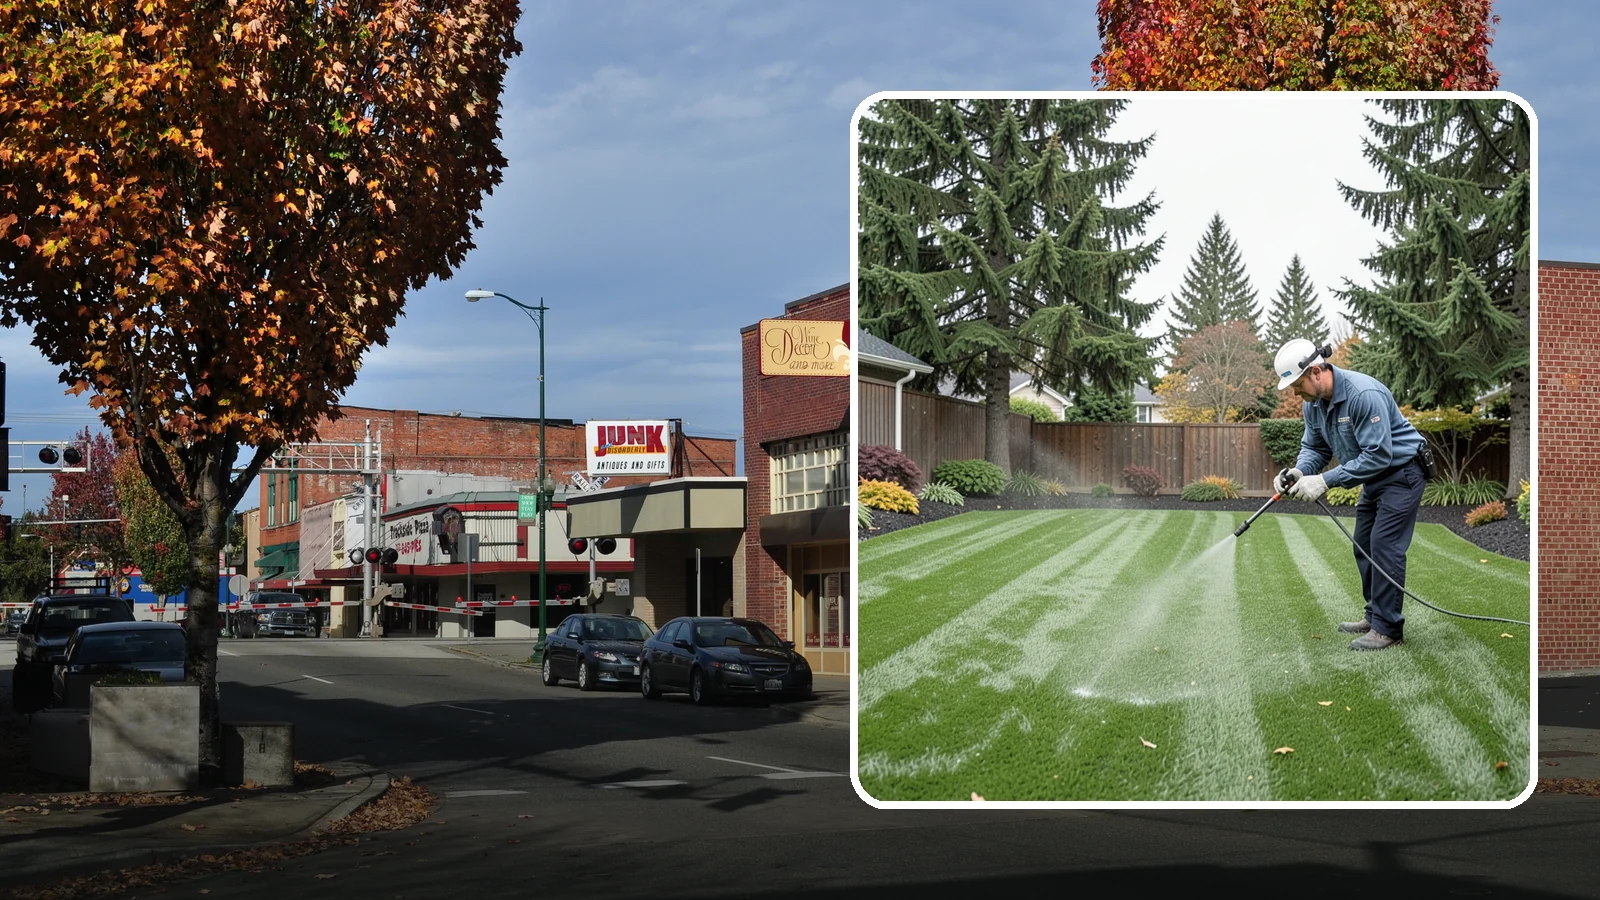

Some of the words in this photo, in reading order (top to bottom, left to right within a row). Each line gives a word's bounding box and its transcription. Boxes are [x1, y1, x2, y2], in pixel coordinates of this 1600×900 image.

[595, 425, 665, 457] JUNK
[607, 446, 646, 454] DISORDERLY
[597, 461, 628, 470] ANTIQUES
[631, 461, 644, 470] AND
[647, 460, 665, 469] GIFTS
[589, 476, 608, 492] SING
[353, 498, 365, 511] CRO
[390, 521, 413, 540] Trackside
[414, 519, 429, 535] Pizza
